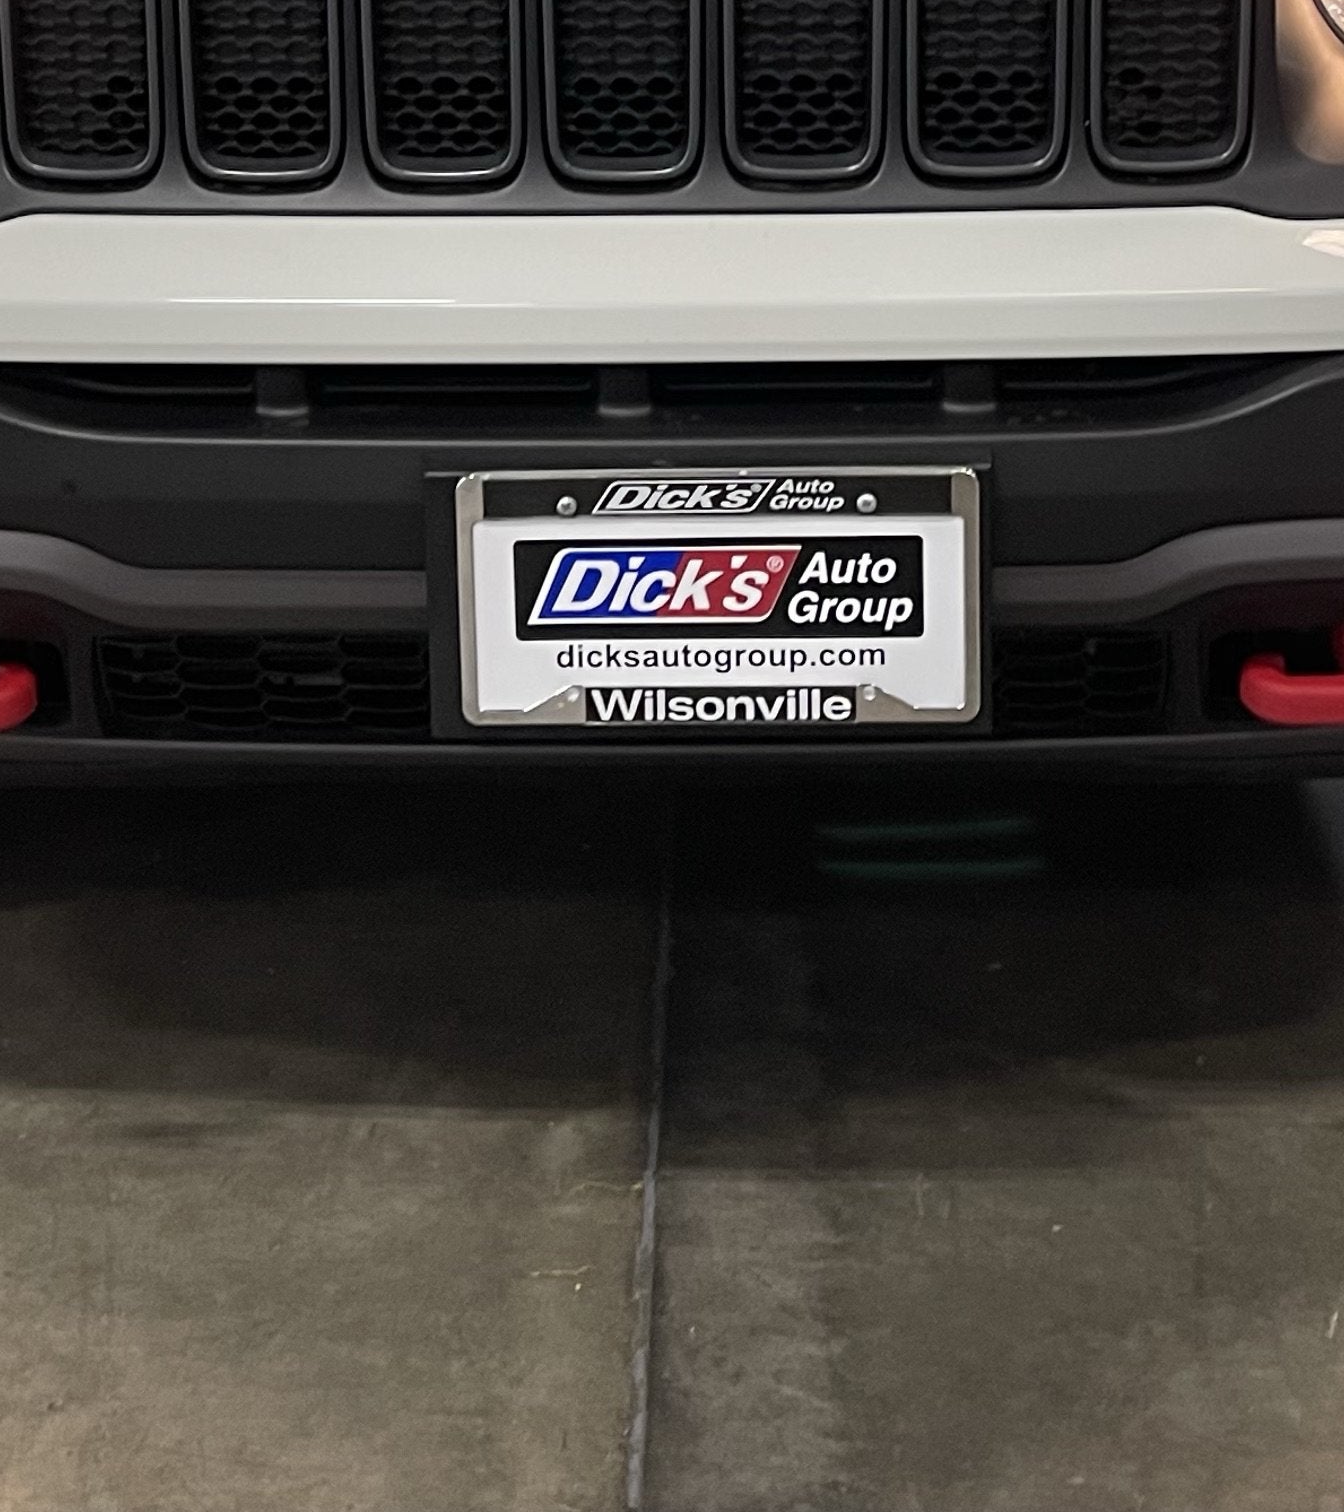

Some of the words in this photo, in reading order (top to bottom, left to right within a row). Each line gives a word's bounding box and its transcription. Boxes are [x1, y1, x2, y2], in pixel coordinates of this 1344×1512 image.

[776, 478, 835, 494] Auto
[770, 493, 845, 512] Group
[799, 551, 897, 585] Auto
[787, 590, 914, 631] Group
[556, 644, 886, 673] dicksautogroup.com
[590, 688, 853, 722] Wilsonville
